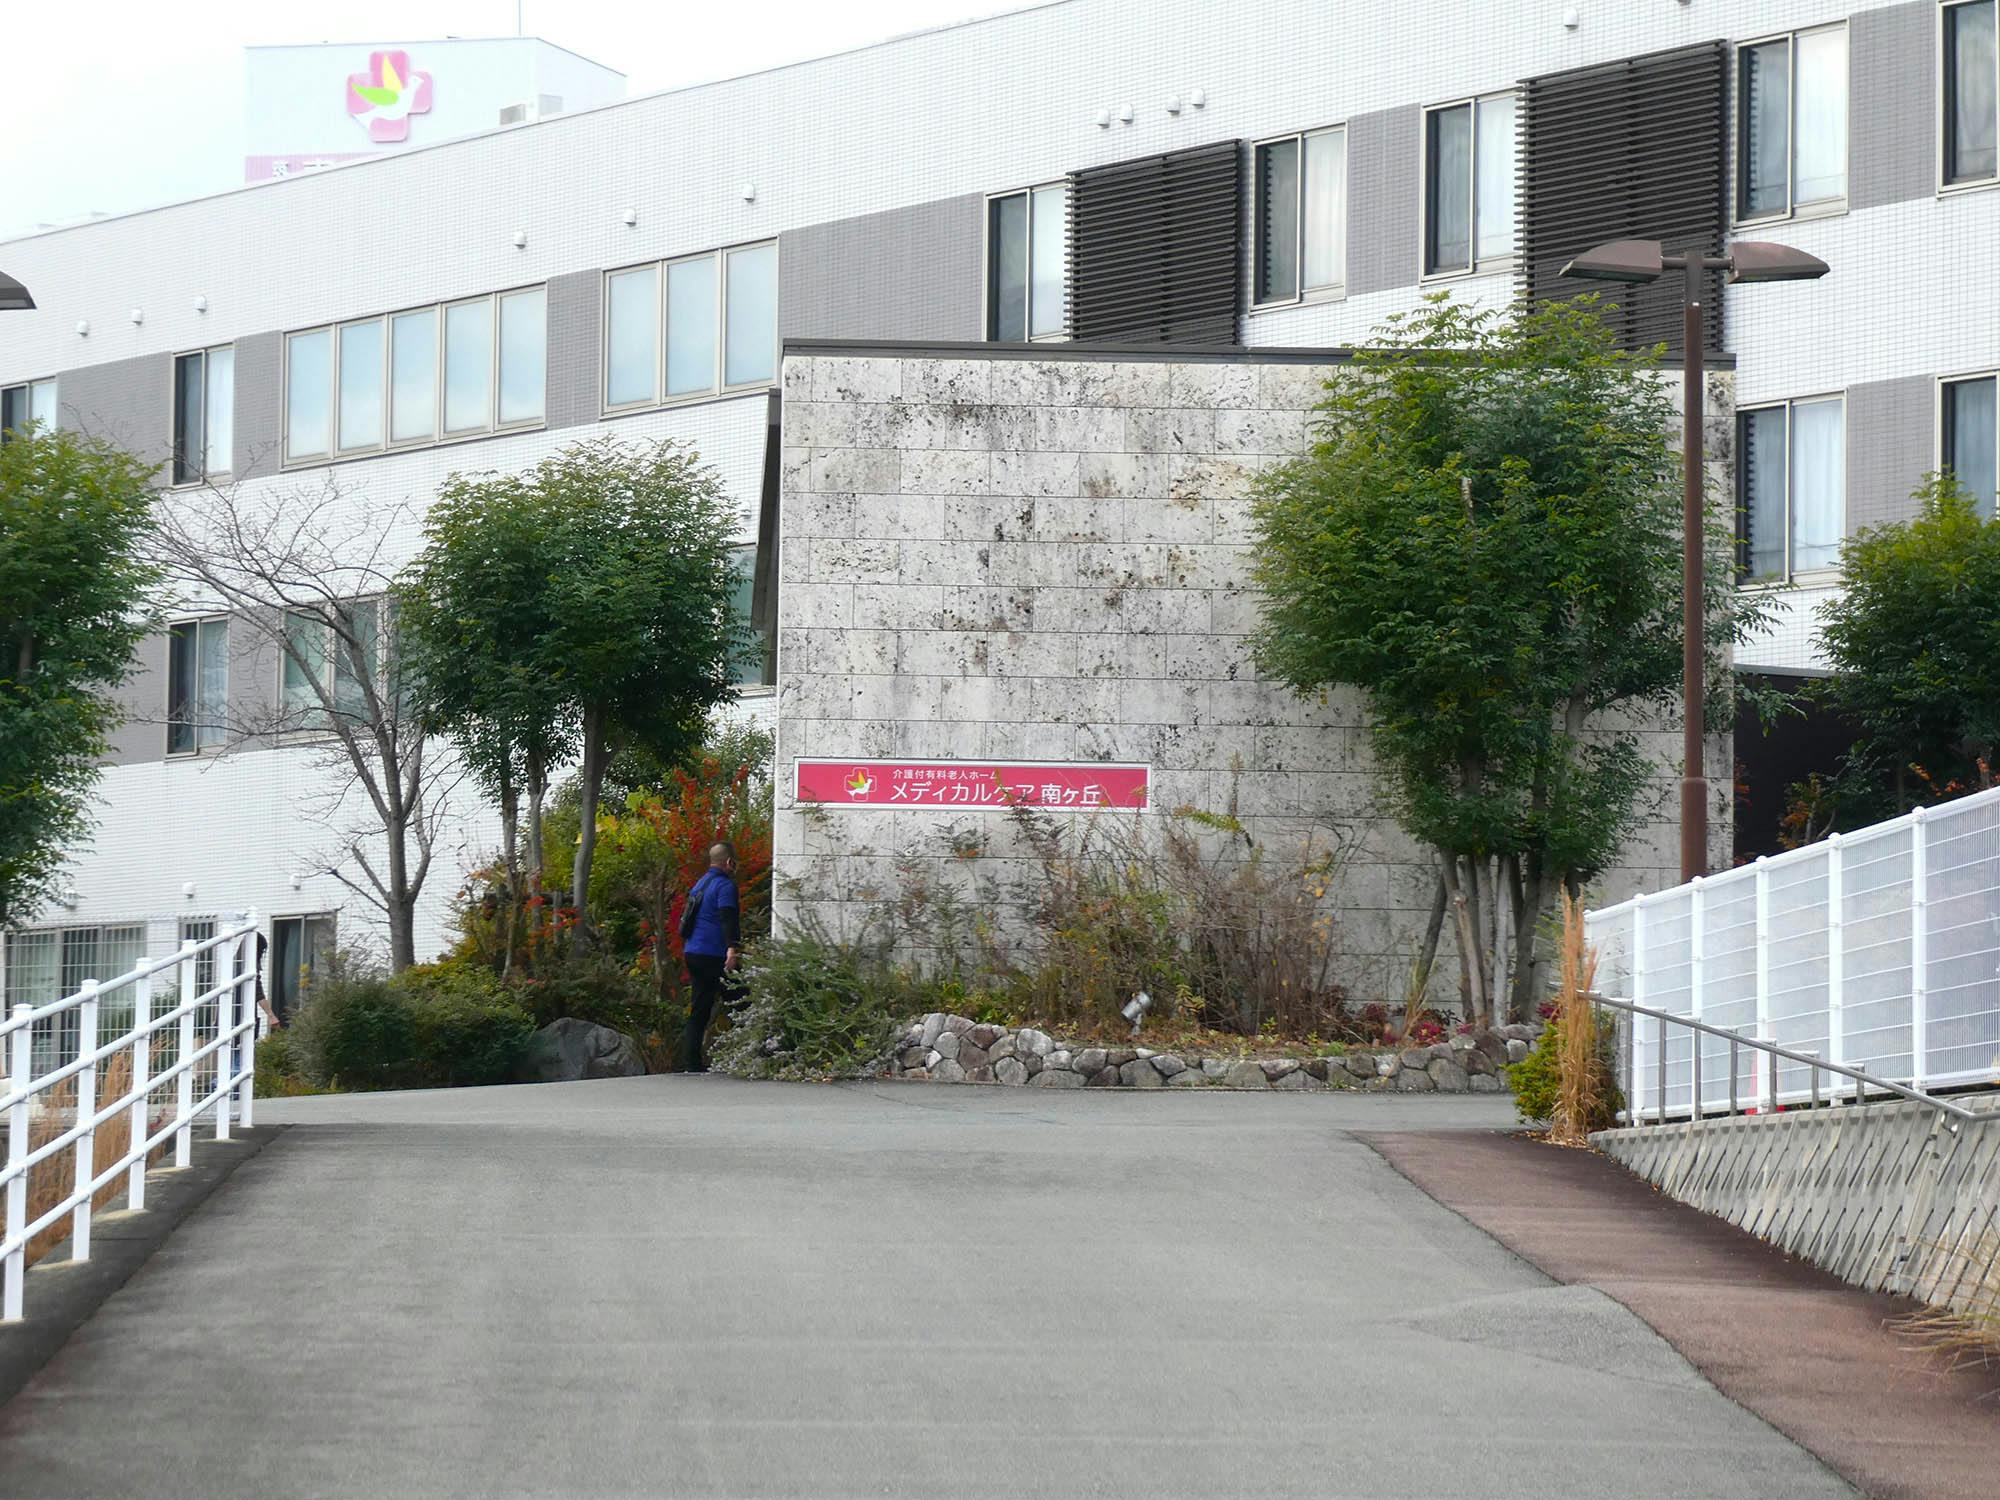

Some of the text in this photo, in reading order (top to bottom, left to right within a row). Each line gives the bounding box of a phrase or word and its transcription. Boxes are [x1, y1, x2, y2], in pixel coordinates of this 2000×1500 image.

[890, 780, 1035, 803] メディカルケア
